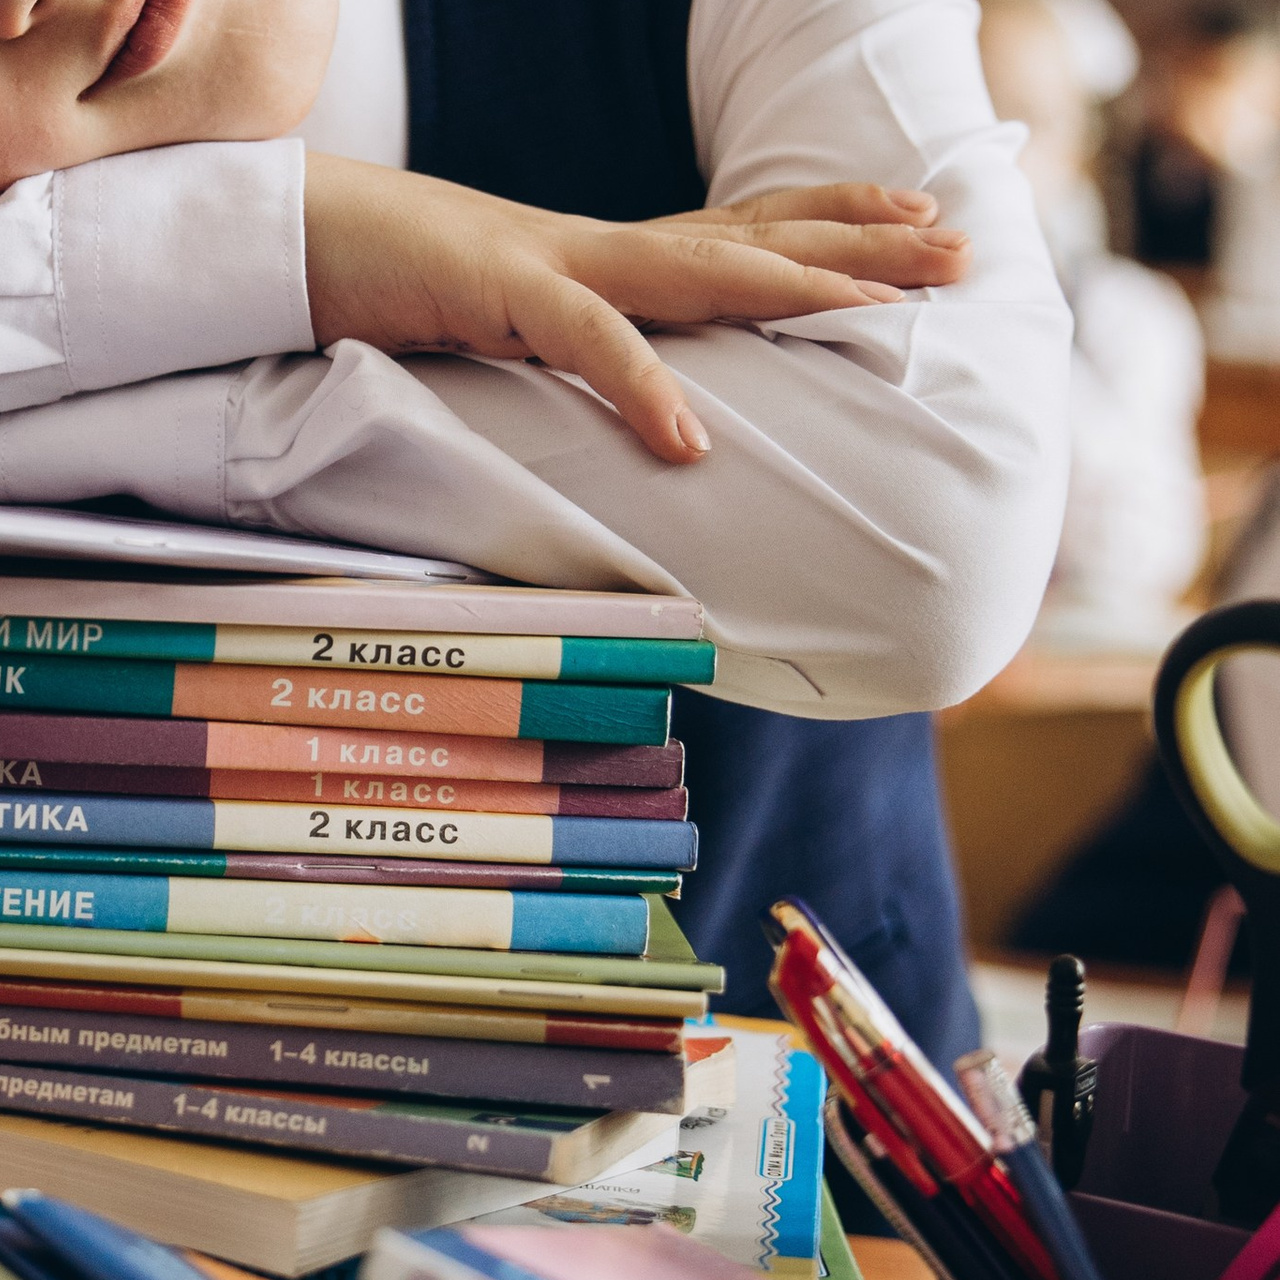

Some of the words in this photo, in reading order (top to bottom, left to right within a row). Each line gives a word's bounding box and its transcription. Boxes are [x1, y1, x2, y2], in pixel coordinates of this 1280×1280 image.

[26, 620, 104, 653] МИР
[311, 633, 334, 663] 2
[348, 640, 467, 670] класс
[270, 677, 293, 707] 2
[307, 684, 426, 716] класс
[305, 736, 320, 762] 1
[339, 740, 450, 769] класс
[310, 772, 324, 798] 1
[343, 776, 456, 805] класс
[308, 810, 331, 839] 2
[344, 816, 460, 846] класс
[264, 896, 287, 925] 2
[300, 903, 418, 931] класс
[77, 1027, 229, 1059] предметам
[324, 1048, 431, 1076] классы
[582, 1072, 611, 1090] 1
[223, 1104, 328, 1135] классы
[766, 1160, 782, 1177] ОЛМА
